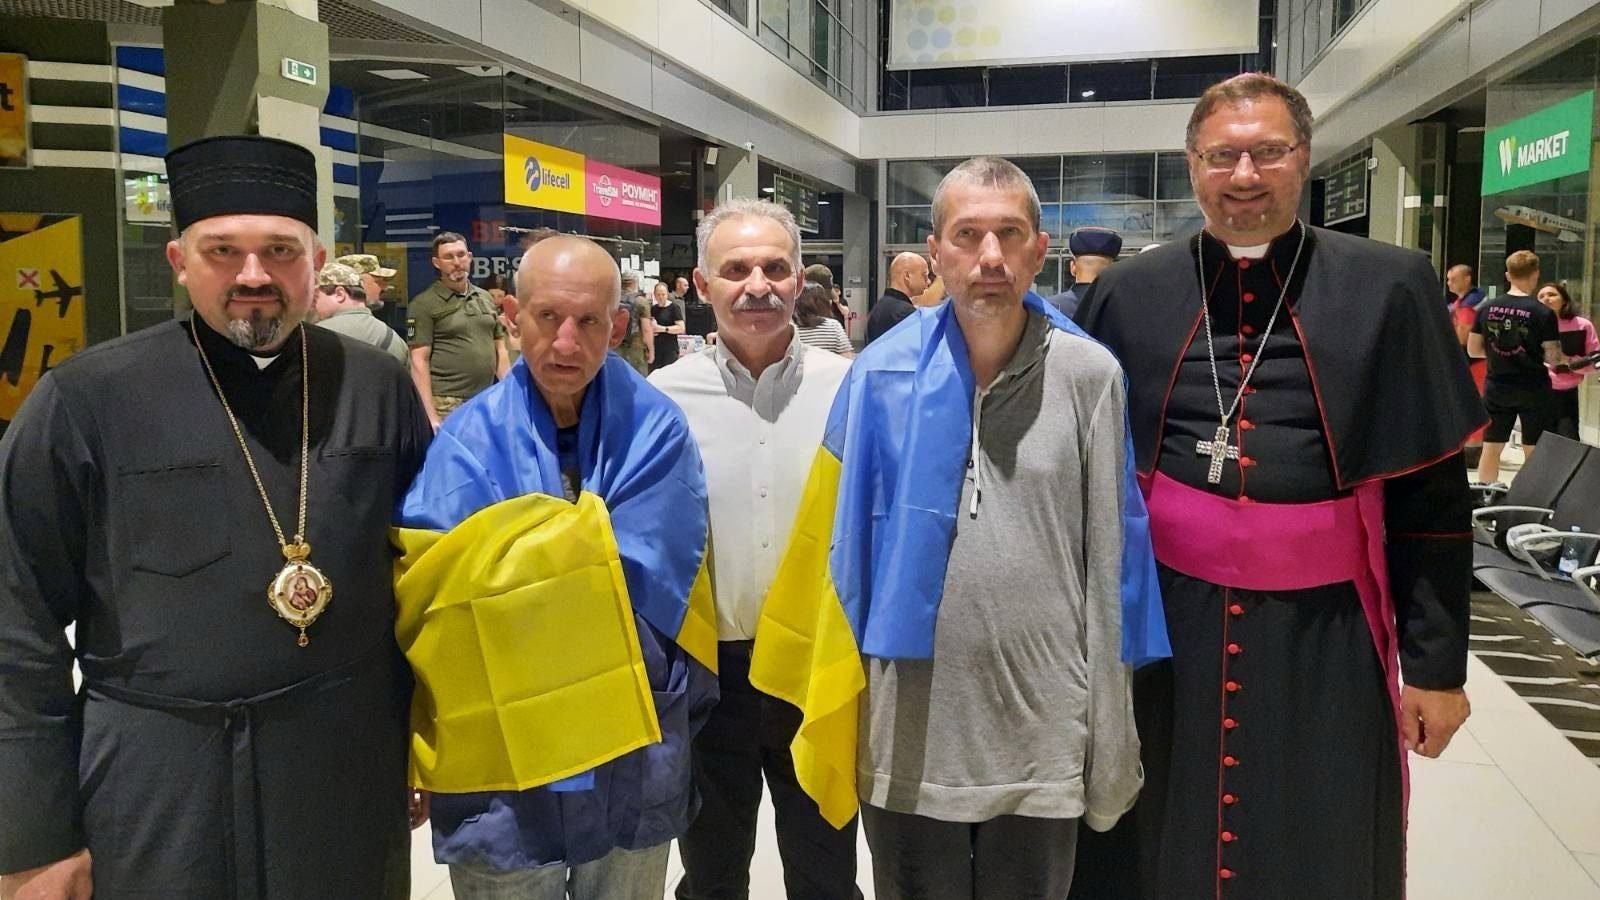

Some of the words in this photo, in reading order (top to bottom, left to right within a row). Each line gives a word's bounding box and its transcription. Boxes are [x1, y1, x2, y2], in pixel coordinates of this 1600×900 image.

[1517, 130, 1570, 168] MARKET
[541, 167, 570, 190] lifecell
[621, 182, 658, 203] РОУМІНГ
[1516, 309, 1531, 318] THE
